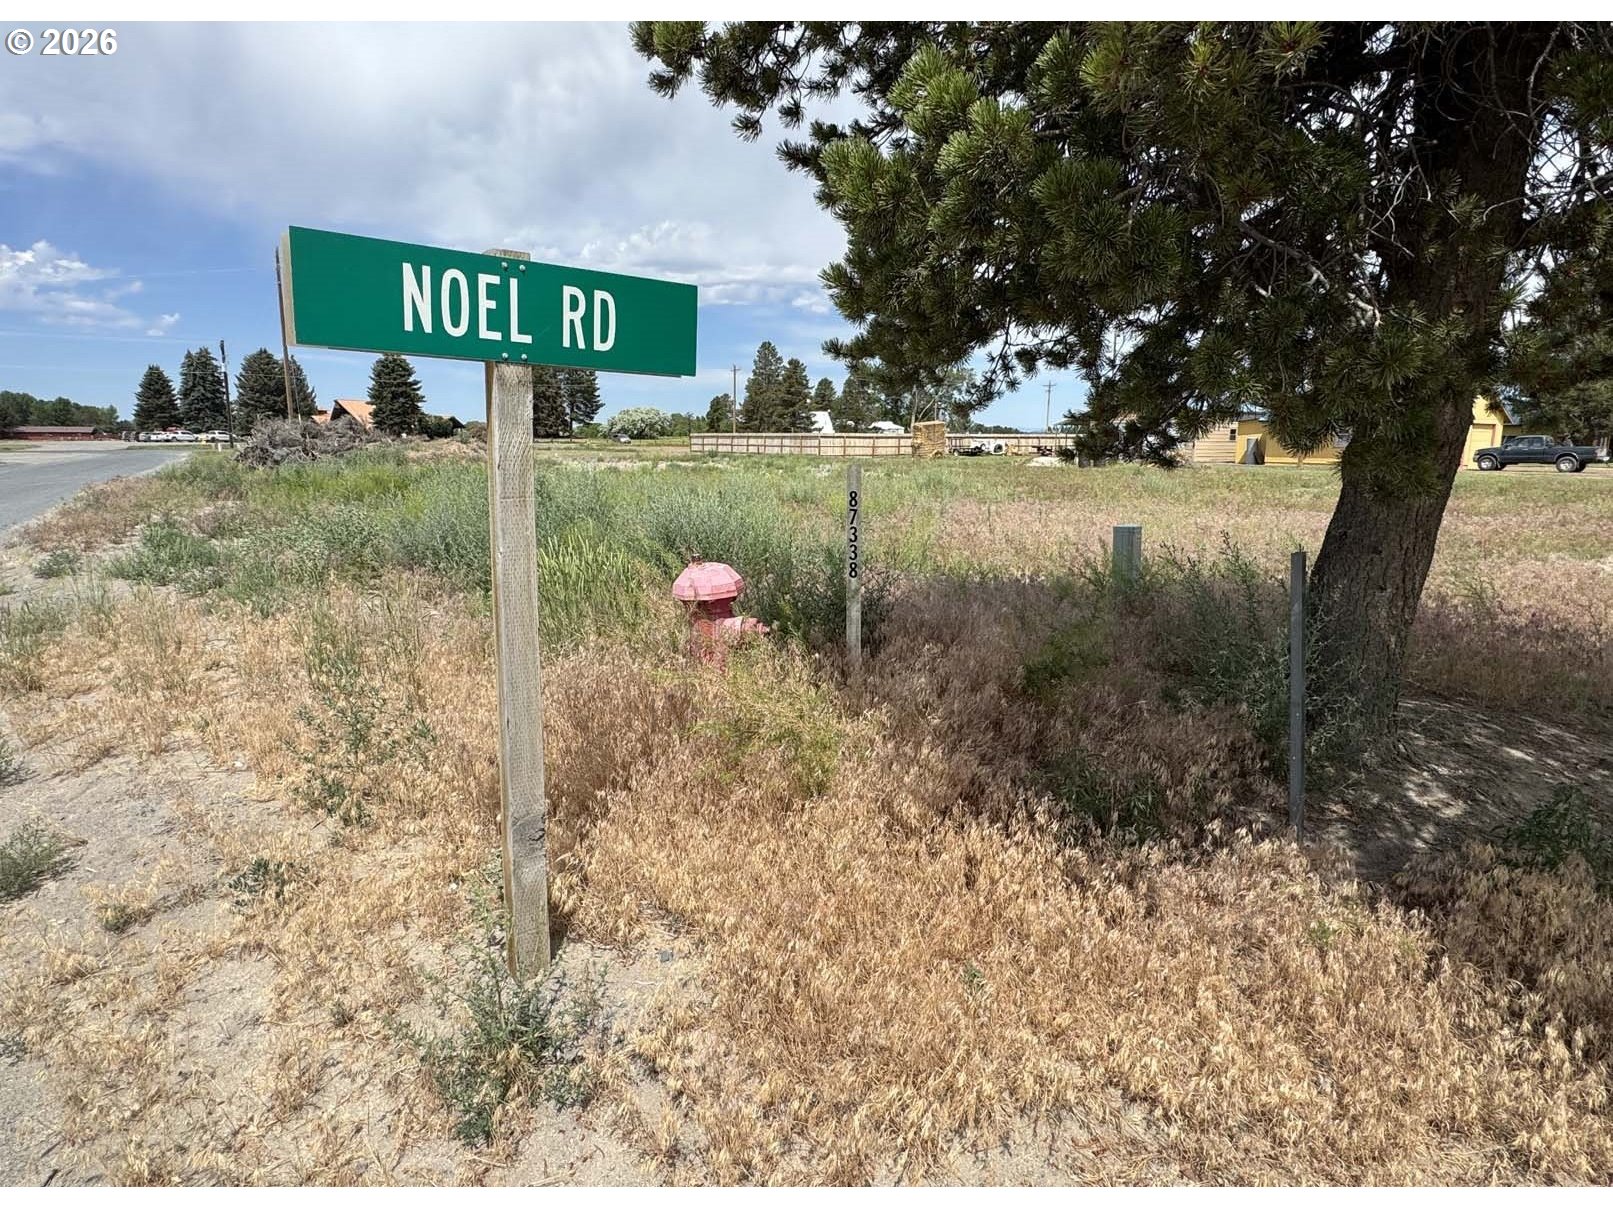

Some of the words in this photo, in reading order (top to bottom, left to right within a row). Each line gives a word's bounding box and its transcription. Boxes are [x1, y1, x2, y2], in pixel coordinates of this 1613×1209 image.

[402, 262, 533, 344] NOEL
[562, 285, 616, 352] RD
[849, 490, 858, 579] 87338
